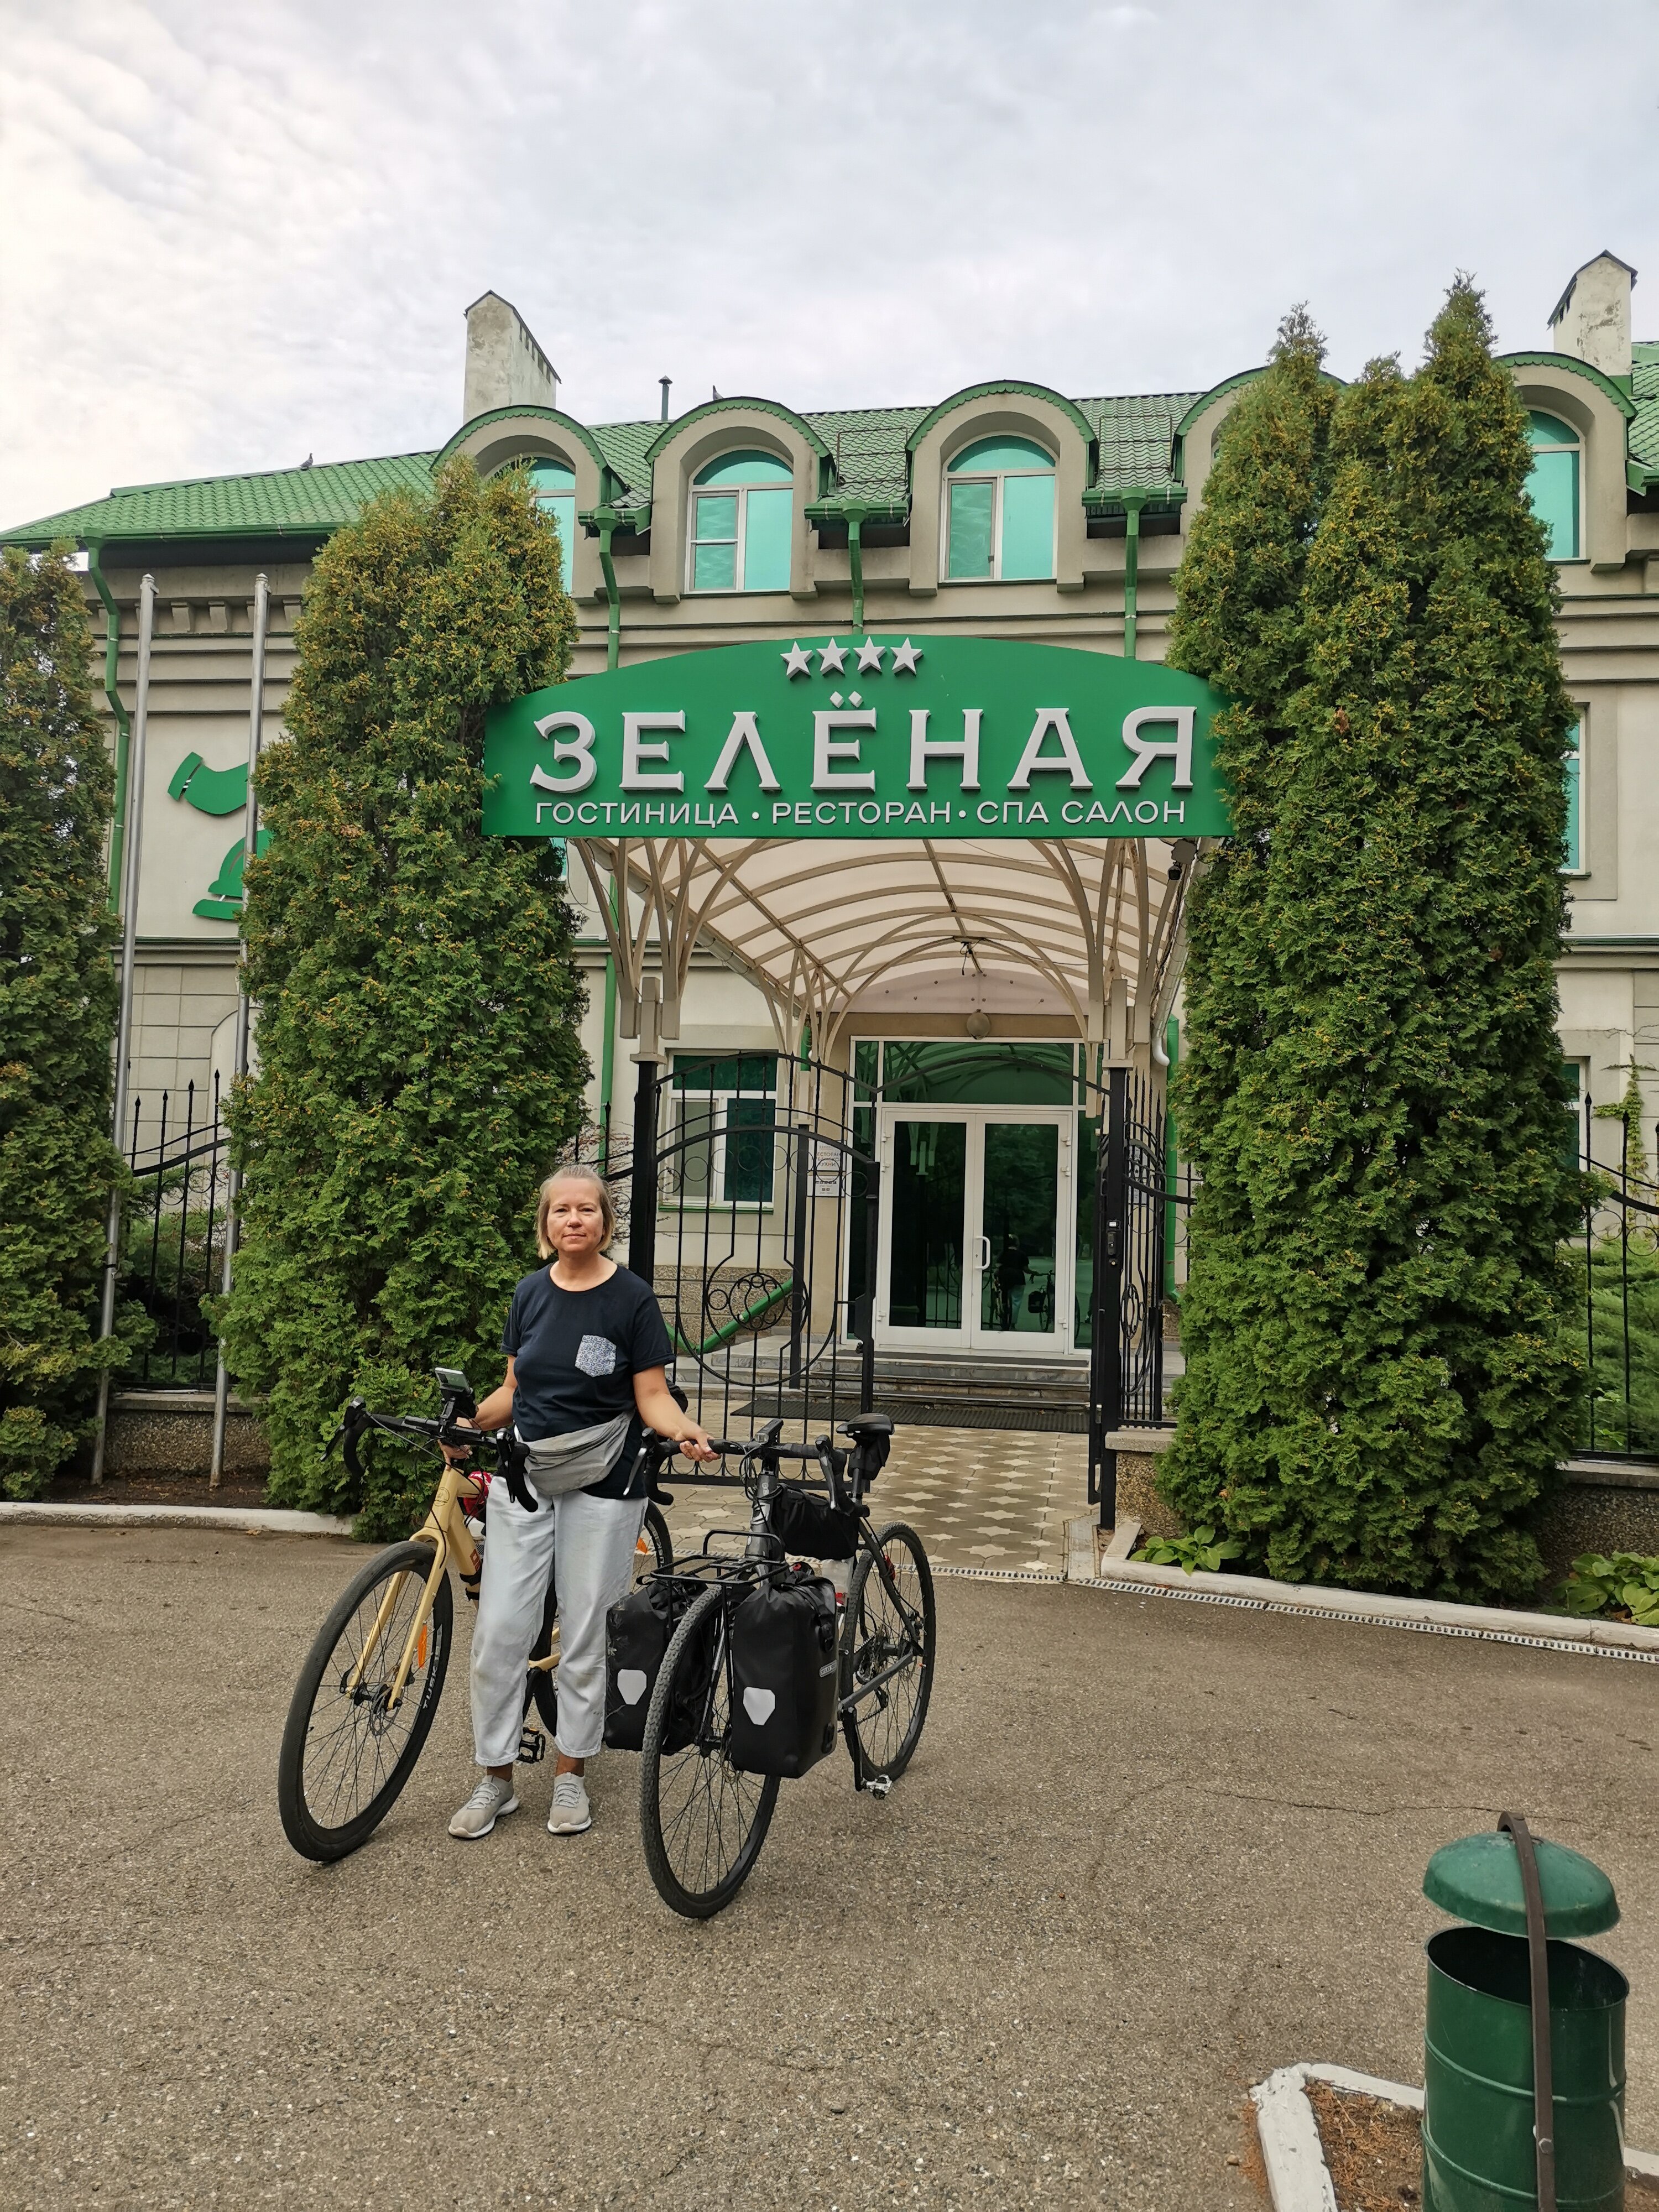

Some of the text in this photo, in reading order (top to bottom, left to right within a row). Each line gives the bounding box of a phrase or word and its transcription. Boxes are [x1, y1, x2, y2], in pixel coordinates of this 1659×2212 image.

[530, 691, 1198, 793] ЗЕЛЁНАЯ
[535, 800, 1185, 828] ГОСТИНИЦА РЕСТОРАН СПА САЛОН
[422, 1666, 438, 1709] TUSK
